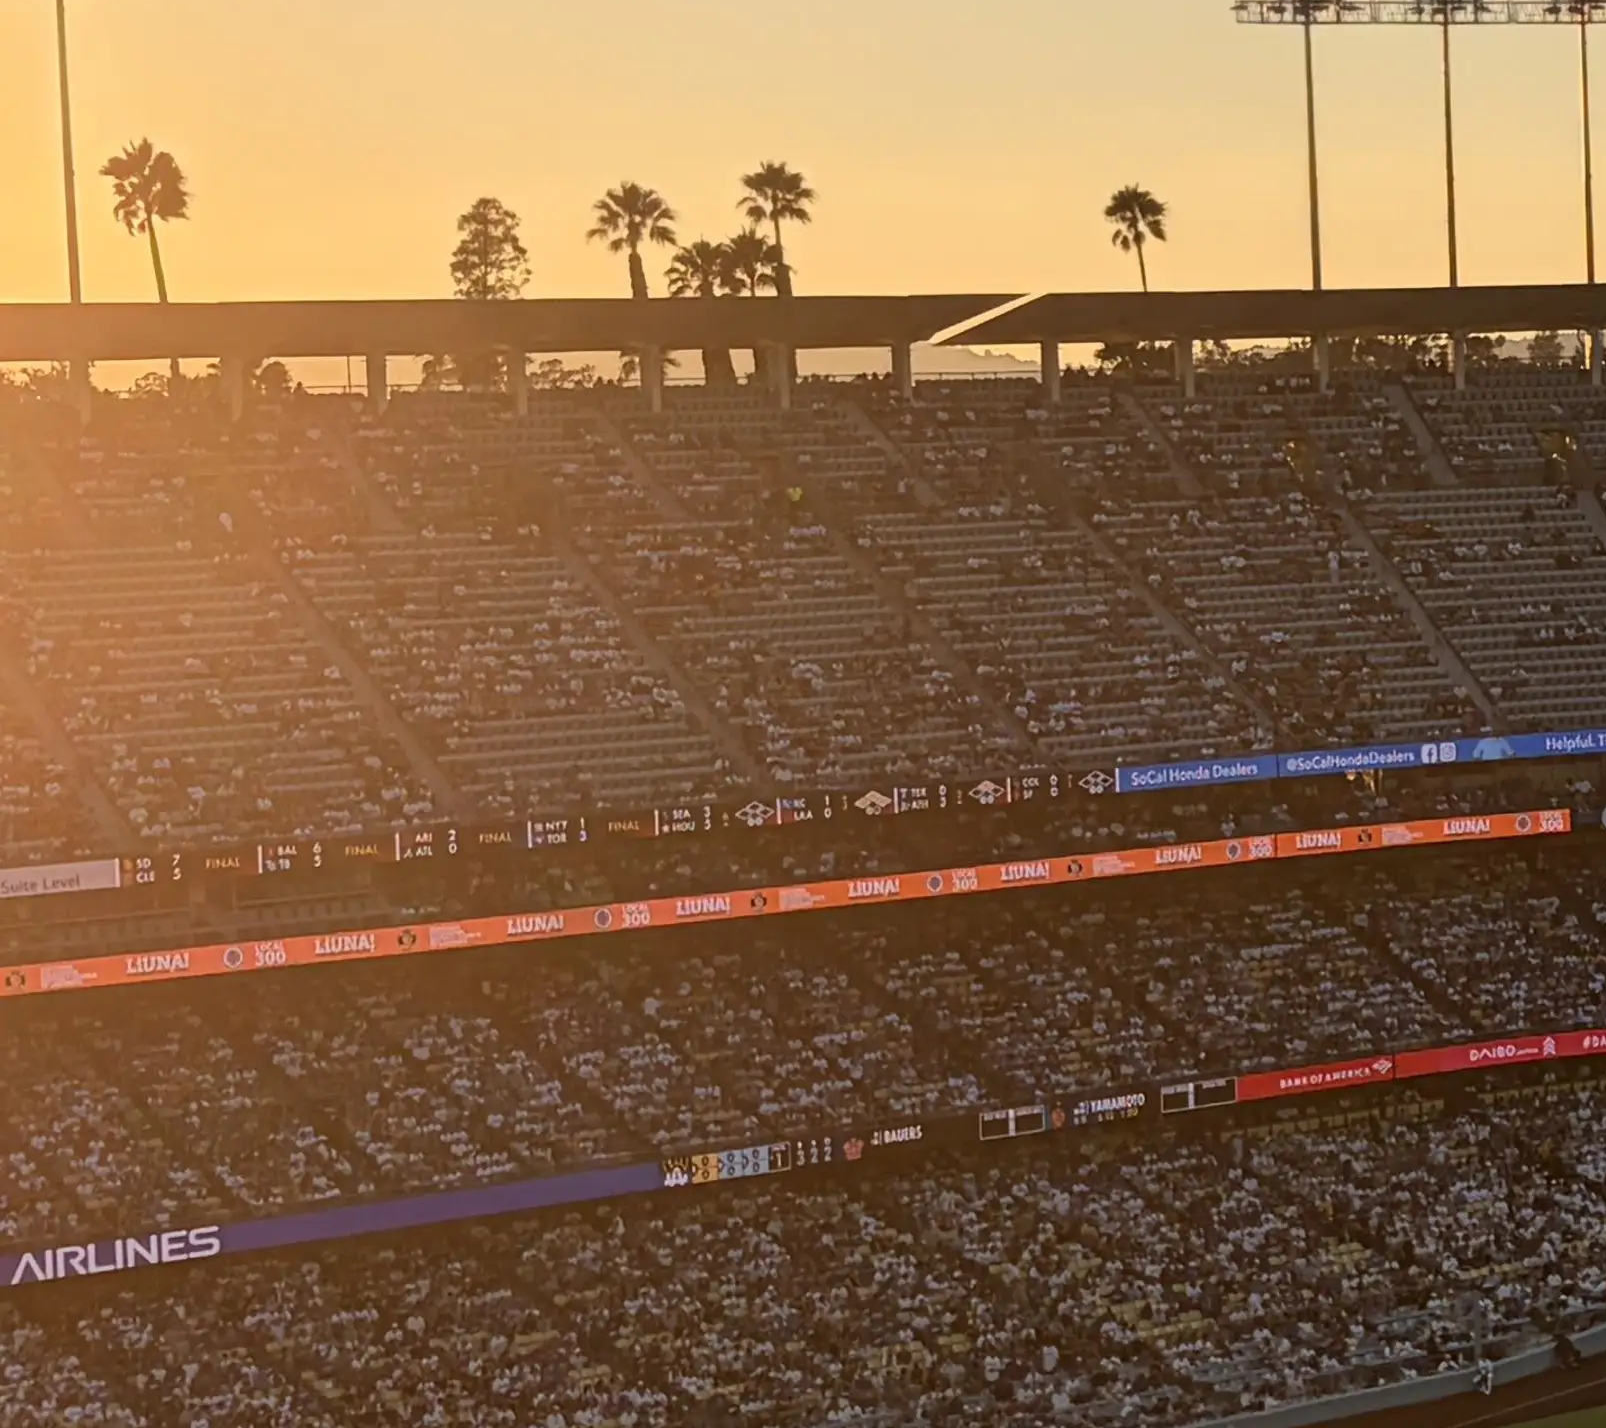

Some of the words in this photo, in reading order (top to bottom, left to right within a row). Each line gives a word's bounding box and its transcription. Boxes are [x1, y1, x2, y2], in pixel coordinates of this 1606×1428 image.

[1545, 735, 1595, 752] Helpful.
[1286, 749, 1415, 771] @SoCalHondaDealers
[1131, 767, 1167, 786] SoCal
[1169, 764, 1210, 782] Honda
[1213, 762, 1258, 779] Dealers
[824, 808, 832, 818] 0
[448, 829, 456, 841] 2
[608, 821, 639, 832] FINAL
[479, 833, 512, 844] FINAL
[312, 842, 322, 853] 6
[345, 845, 379, 856] FINAL
[448, 843, 457, 853] 0
[1154, 845, 1203, 864] LIUNA!
[136, 858, 151, 869] SD
[172, 854, 181, 866] 7
[205, 857, 240, 869] FINAL
[1000, 861, 1049, 881] LIUNA!
[1, 877, 38, 894] Suite
[42, 874, 81, 890] Level
[848, 878, 900, 897] LIUNA!
[952, 878, 978, 892] 300
[676, 896, 730, 916] LIUNA!
[507, 915, 564, 935] LIUNA!
[622, 912, 651, 927] 300
[315, 933, 375, 954] LIUNA!
[126, 952, 190, 973] LIUNA!
[255, 952, 286, 965] 300
[1470, 1045, 1516, 1061] DAISO
[1280, 1077, 1309, 1089] BANK
[1310, 1074, 1323, 1085] OF
[1325, 1067, 1371, 1082] AMERICA
[1090, 1093, 1145, 1113] YAMAMOTO
[884, 1125, 923, 1143] BAUERS
[727, 1152, 735, 1163] 0
[752, 1148, 760, 1160] 0
[810, 1148, 819, 1164] 2
[824, 1146, 832, 1162] 2
[727, 1166, 735, 1176] 0
[752, 1162, 760, 1173] 0
[11, 1226, 221, 1286] AIRLINES
